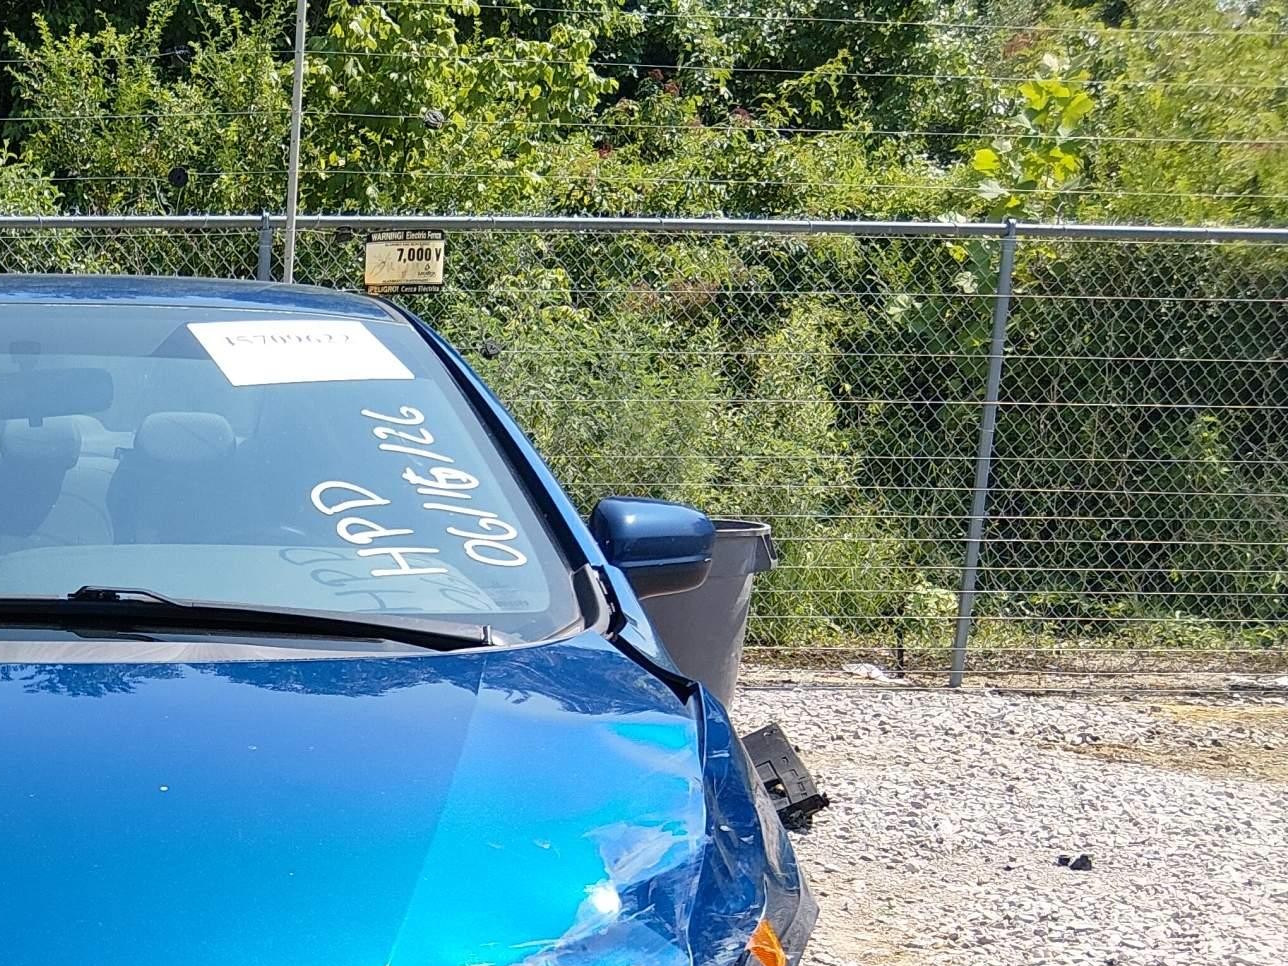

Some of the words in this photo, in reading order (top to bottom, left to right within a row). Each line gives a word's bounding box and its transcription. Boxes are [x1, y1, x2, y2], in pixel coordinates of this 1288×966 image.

[371, 231, 404, 241] WARNING!
[406, 231, 426, 240] Electric
[397, 247, 431, 263] 7,000
[434, 247, 442, 261] V
[310, 480, 449, 576] HPD
